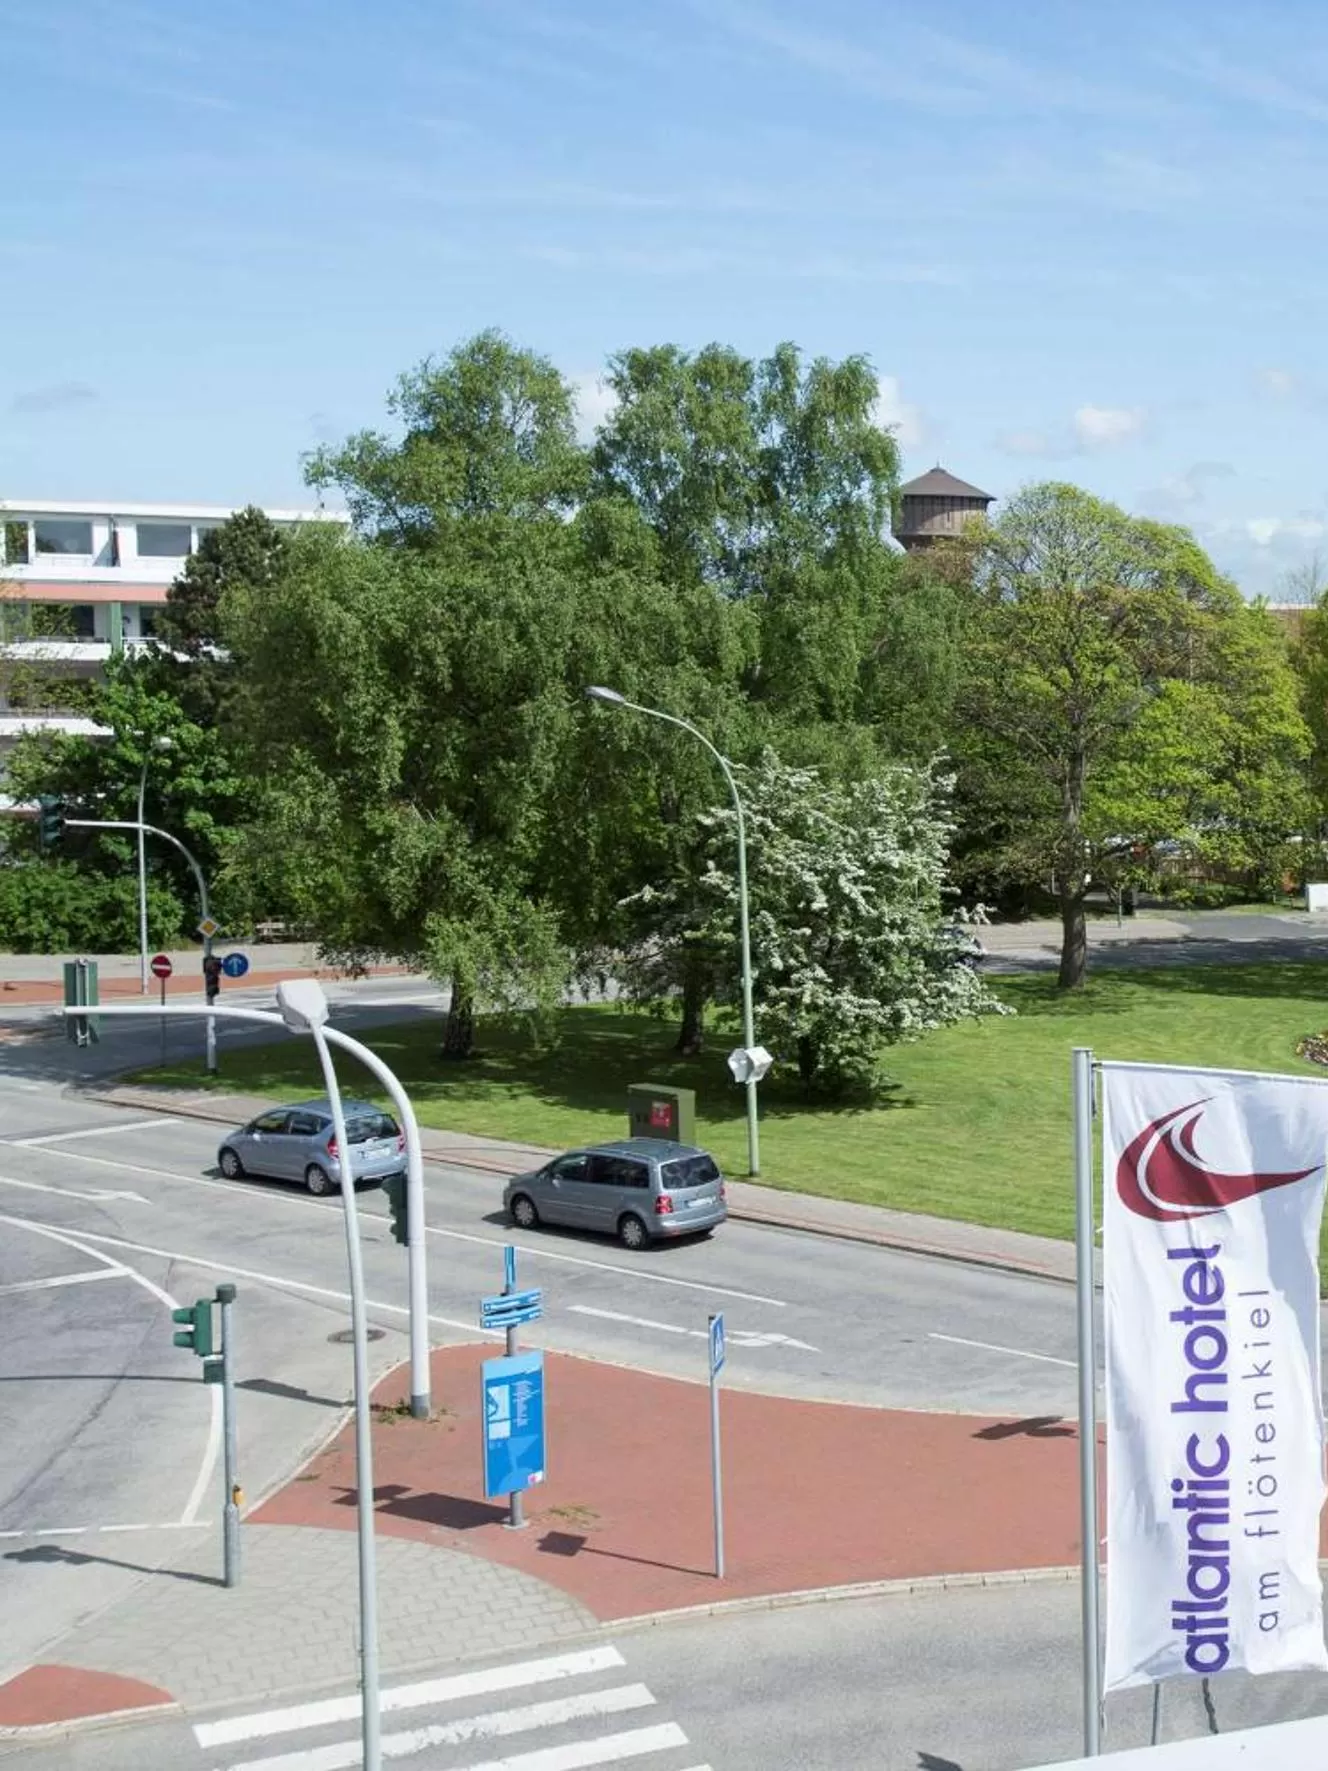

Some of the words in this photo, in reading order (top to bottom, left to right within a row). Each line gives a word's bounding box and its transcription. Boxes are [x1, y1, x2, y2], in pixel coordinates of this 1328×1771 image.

[1167, 1243, 1229, 1415] hotel
[1238, 1289, 1281, 1539] flötenkiel
[1169, 1431, 1231, 1674] atlantic
[1258, 1570, 1281, 1634] am
